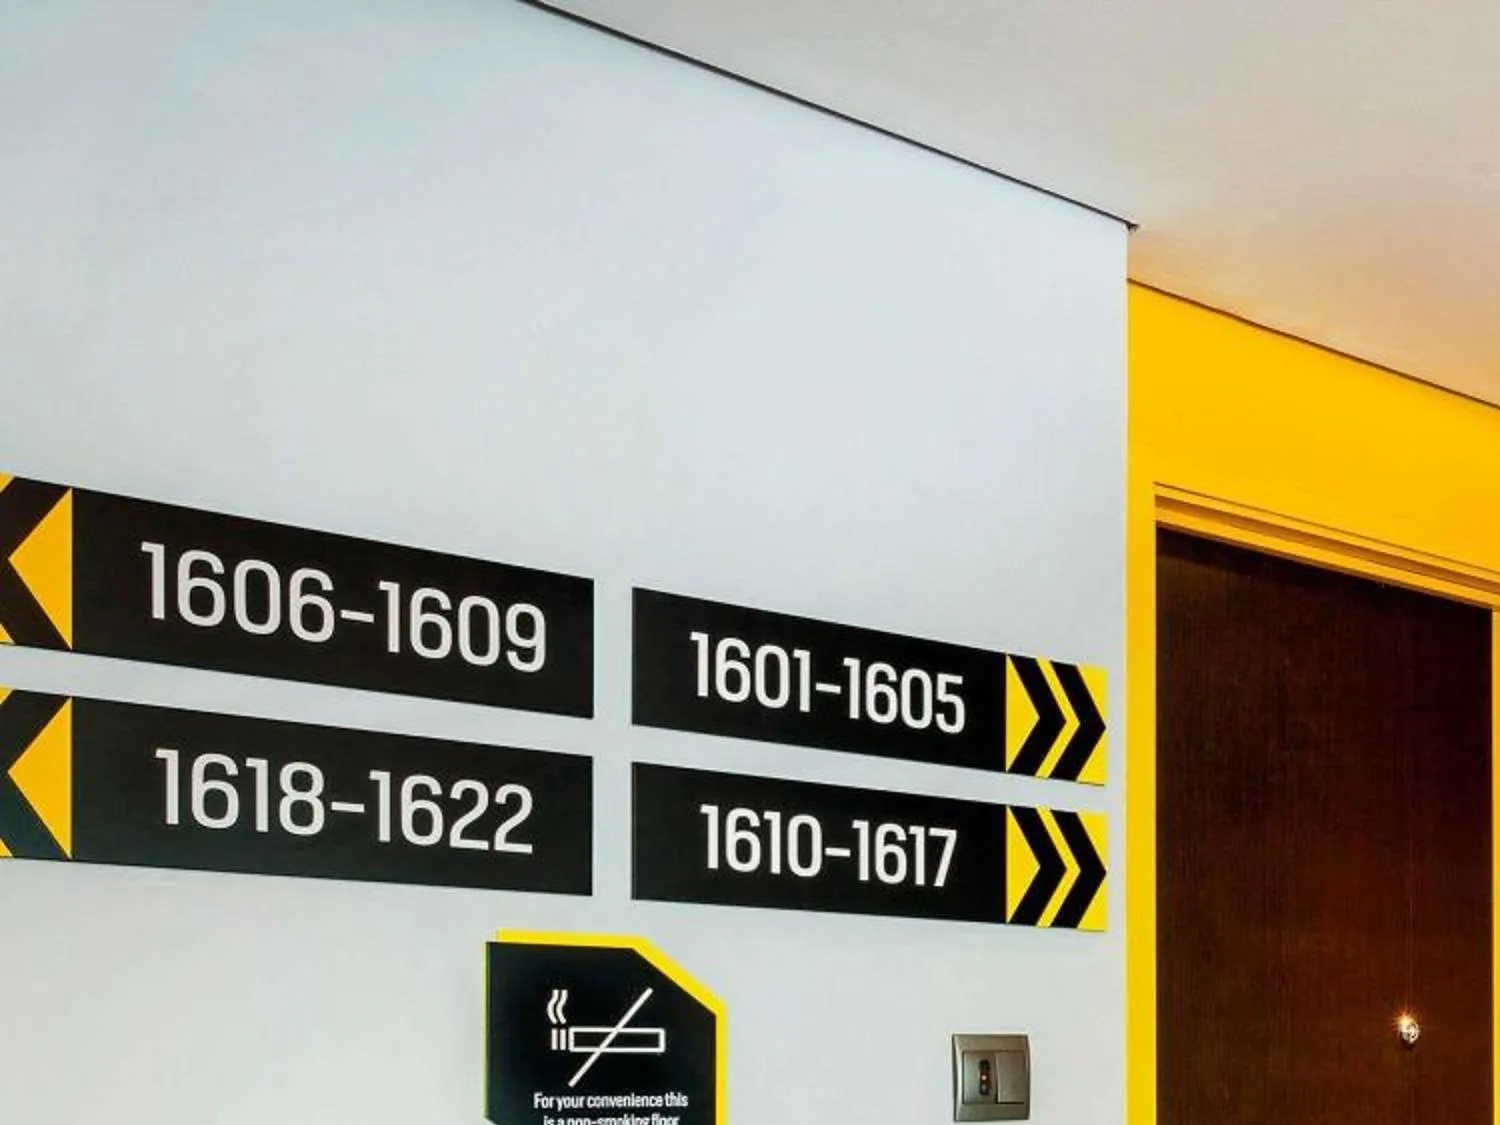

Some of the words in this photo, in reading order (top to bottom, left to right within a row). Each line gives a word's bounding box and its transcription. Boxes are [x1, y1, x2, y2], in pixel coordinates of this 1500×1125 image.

[141, 541, 547, 674] 1606-1609
[690, 631, 966, 734] 1601-1605
[155, 748, 534, 854] 1618-1622
[700, 803, 958, 887] 1610-1617
[533, 1092, 554, 1108] For
[556, 1095, 584, 1111] your
[586, 1092, 663, 1108] convenience
[664, 1091, 688, 1107] this
